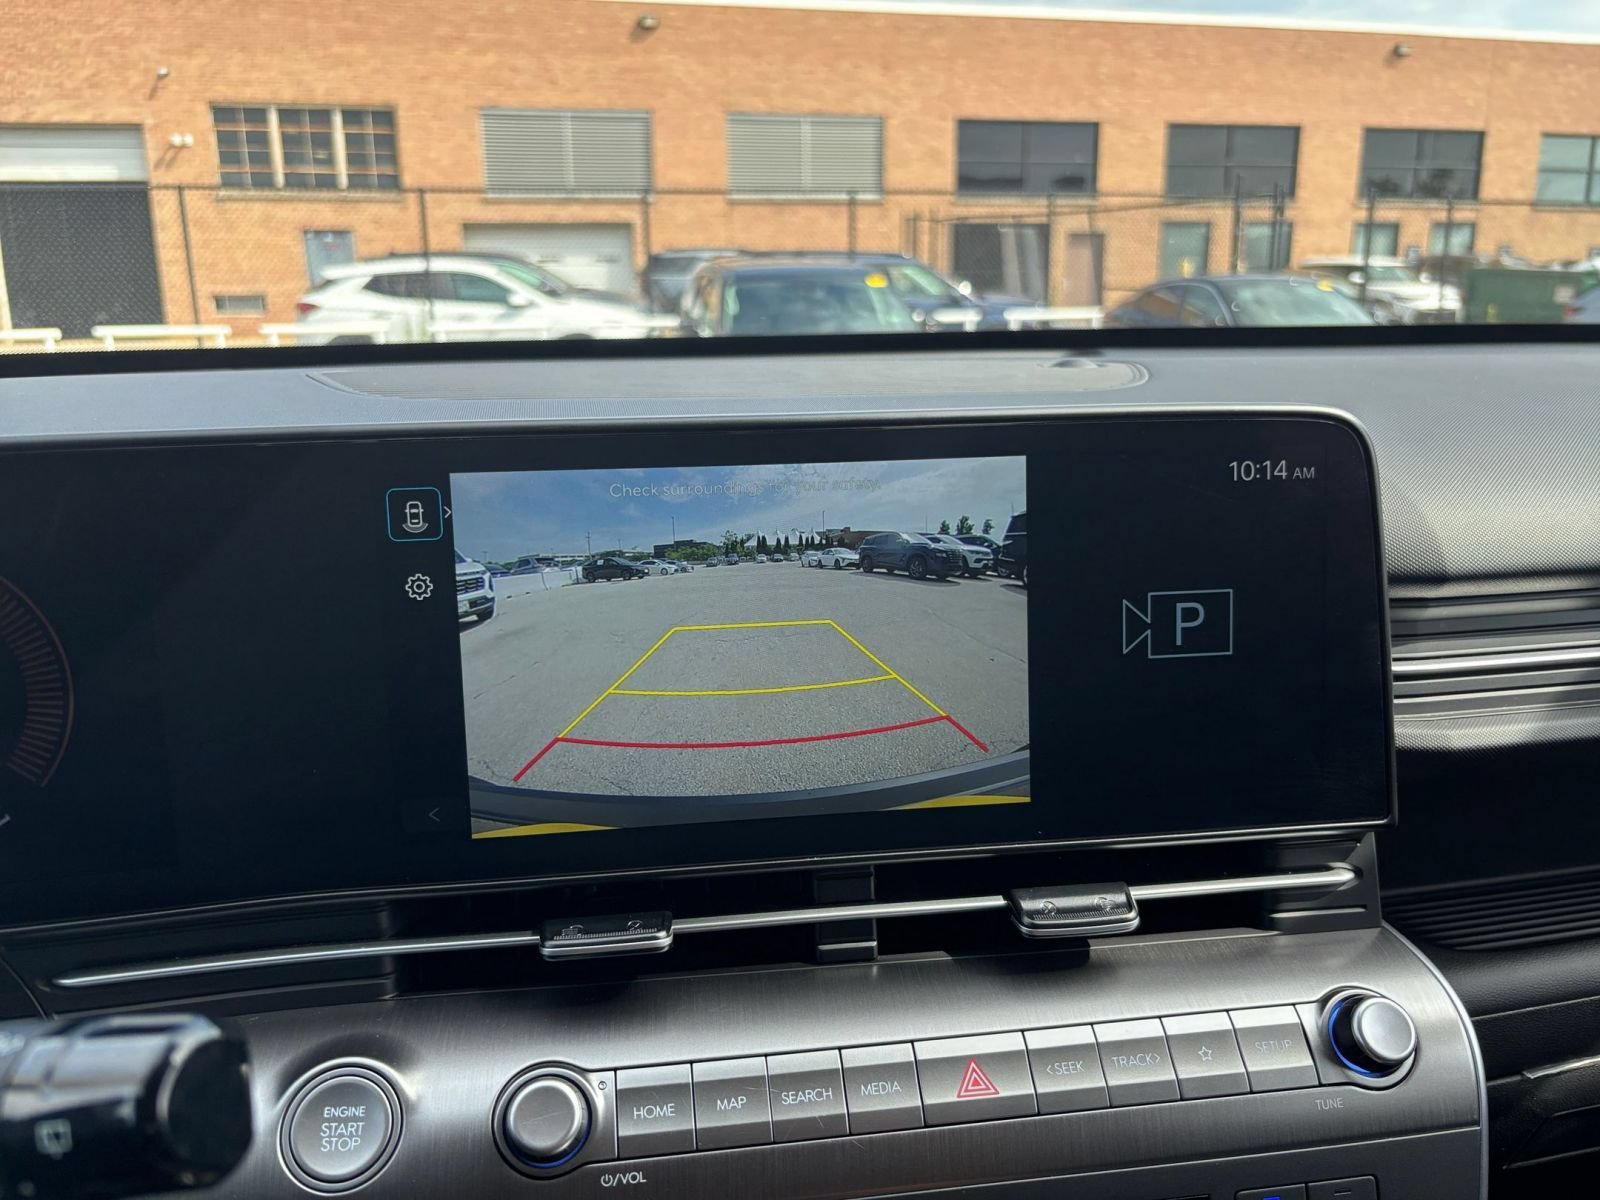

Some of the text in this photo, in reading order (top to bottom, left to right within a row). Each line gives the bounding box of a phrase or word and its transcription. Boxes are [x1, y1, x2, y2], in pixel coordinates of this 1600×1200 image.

[1229, 460, 1315, 481] 10:14 AM
[609, 483, 659, 498] Check
[1175, 602, 1206, 646] P
[1254, 1040, 1293, 1053] SETUP
[781, 1087, 833, 1105] SEARCH
[861, 1081, 902, 1096] MEDIA
[716, 1096, 747, 1111] MAP
[1315, 1098, 1345, 1111] TUNE
[324, 1106, 366, 1118] ENGINE
[633, 1103, 676, 1120] HOME
[320, 1122, 365, 1137] START
[320, 1137, 361, 1152] STOP
